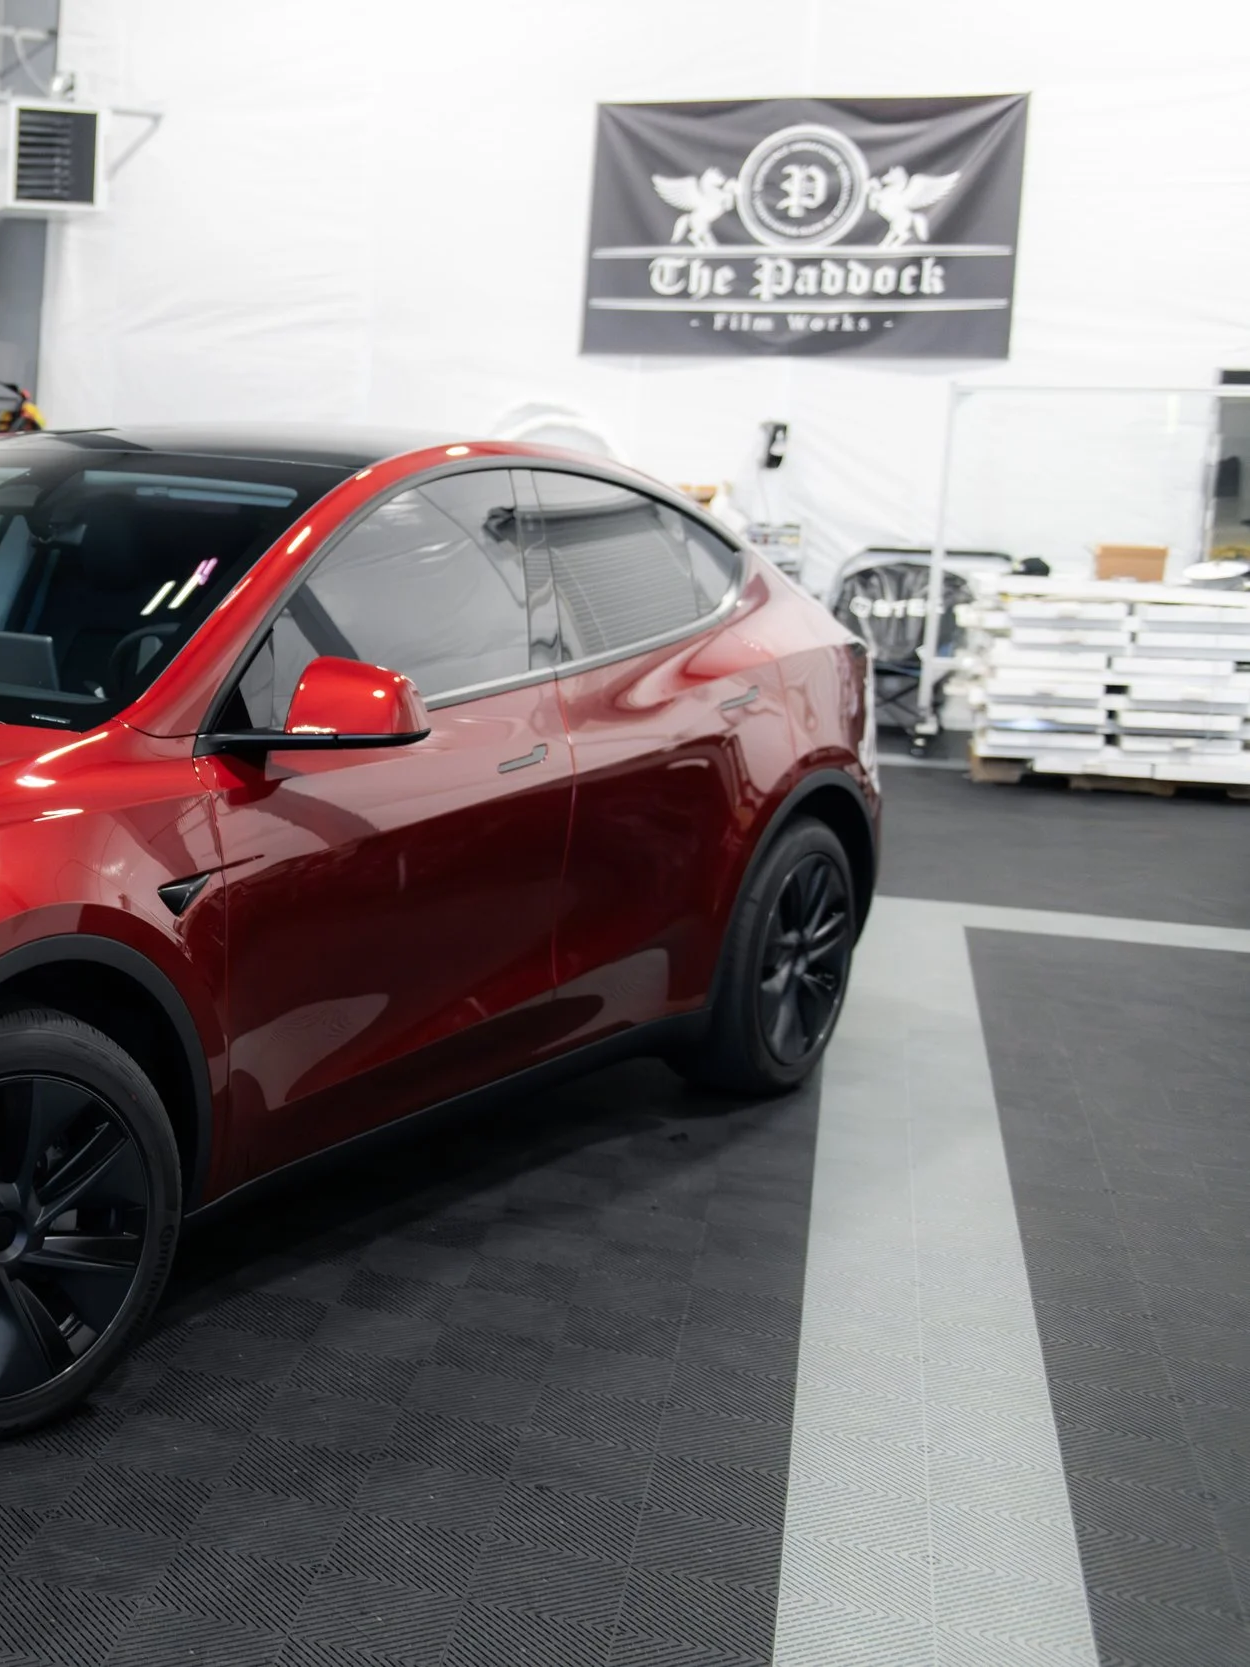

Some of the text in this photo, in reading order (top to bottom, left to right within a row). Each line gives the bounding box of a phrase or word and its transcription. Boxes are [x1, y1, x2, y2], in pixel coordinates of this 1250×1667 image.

[649, 255, 946, 300] The Paddock
[713, 313, 871, 332] Film Works
